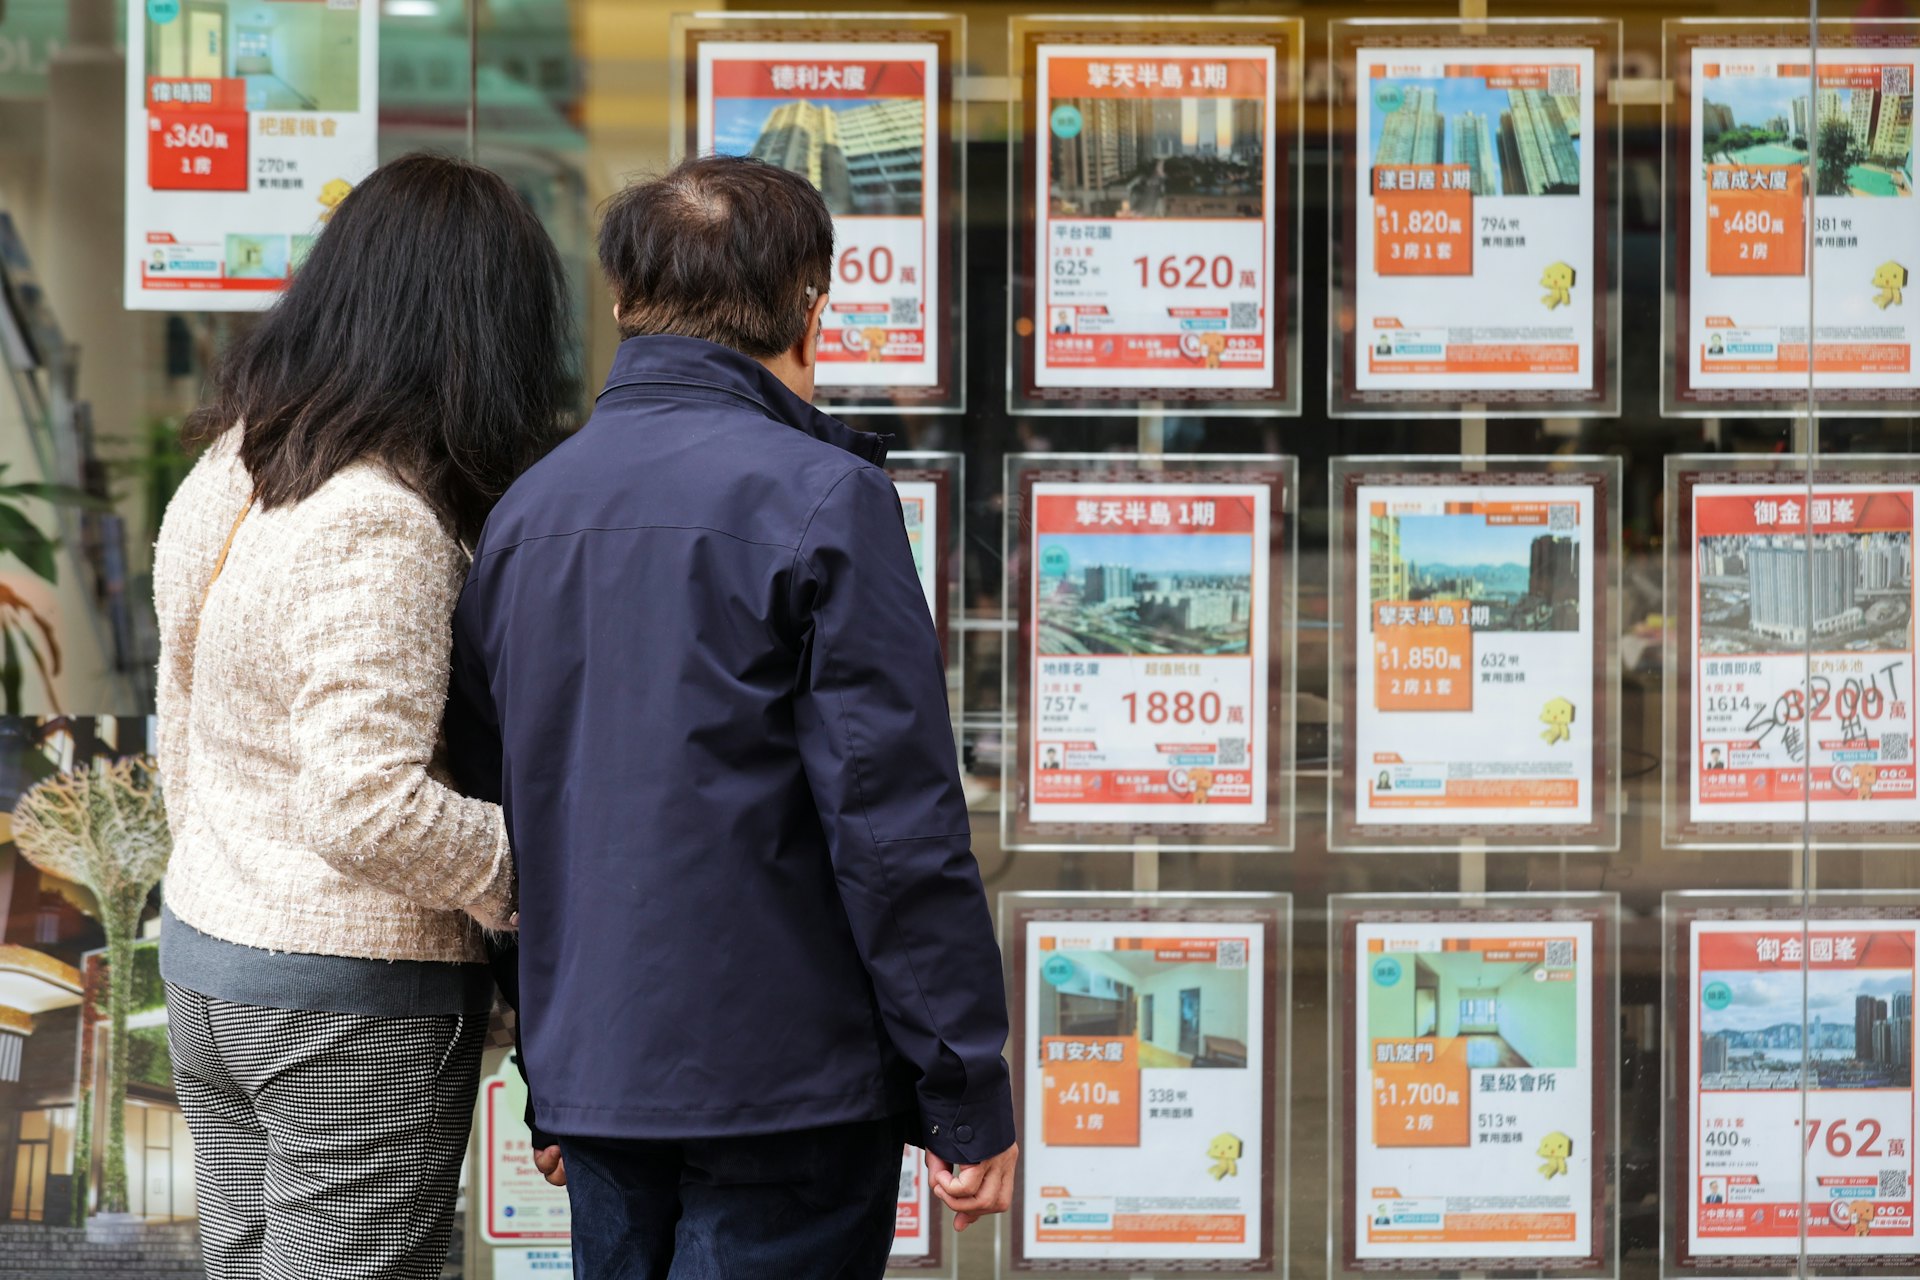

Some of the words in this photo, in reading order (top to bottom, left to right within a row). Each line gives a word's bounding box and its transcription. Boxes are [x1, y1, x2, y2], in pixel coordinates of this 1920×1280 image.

[771, 65, 866, 91] 德利大廈
[1088, 63, 1183, 88] 擎天半島
[1190, 63, 1227, 89] 1期
[259, 117, 337, 137] 把握機會
[1441, 169, 1471, 190] 1期
[1711, 169, 1788, 190] 嘉成大廈
[1055, 225, 1112, 240] 平台花園
[1481, 237, 1526, 248] 實用面積
[830, 245, 916, 285] 60萬
[1076, 501, 1171, 526] 擎天半島
[1178, 501, 1216, 526] 1期
[1378, 605, 1455, 626] 擎天半島
[1461, 605, 1490, 626] 1期
[1481, 672, 1526, 683] 實用面積
[1842, 661, 1904, 711] OUT
[1376, 1042, 1435, 1063] 凱旋門
[1480, 1073, 1556, 1093] 星級會所
[1479, 1132, 1523, 1143] 實用面積
